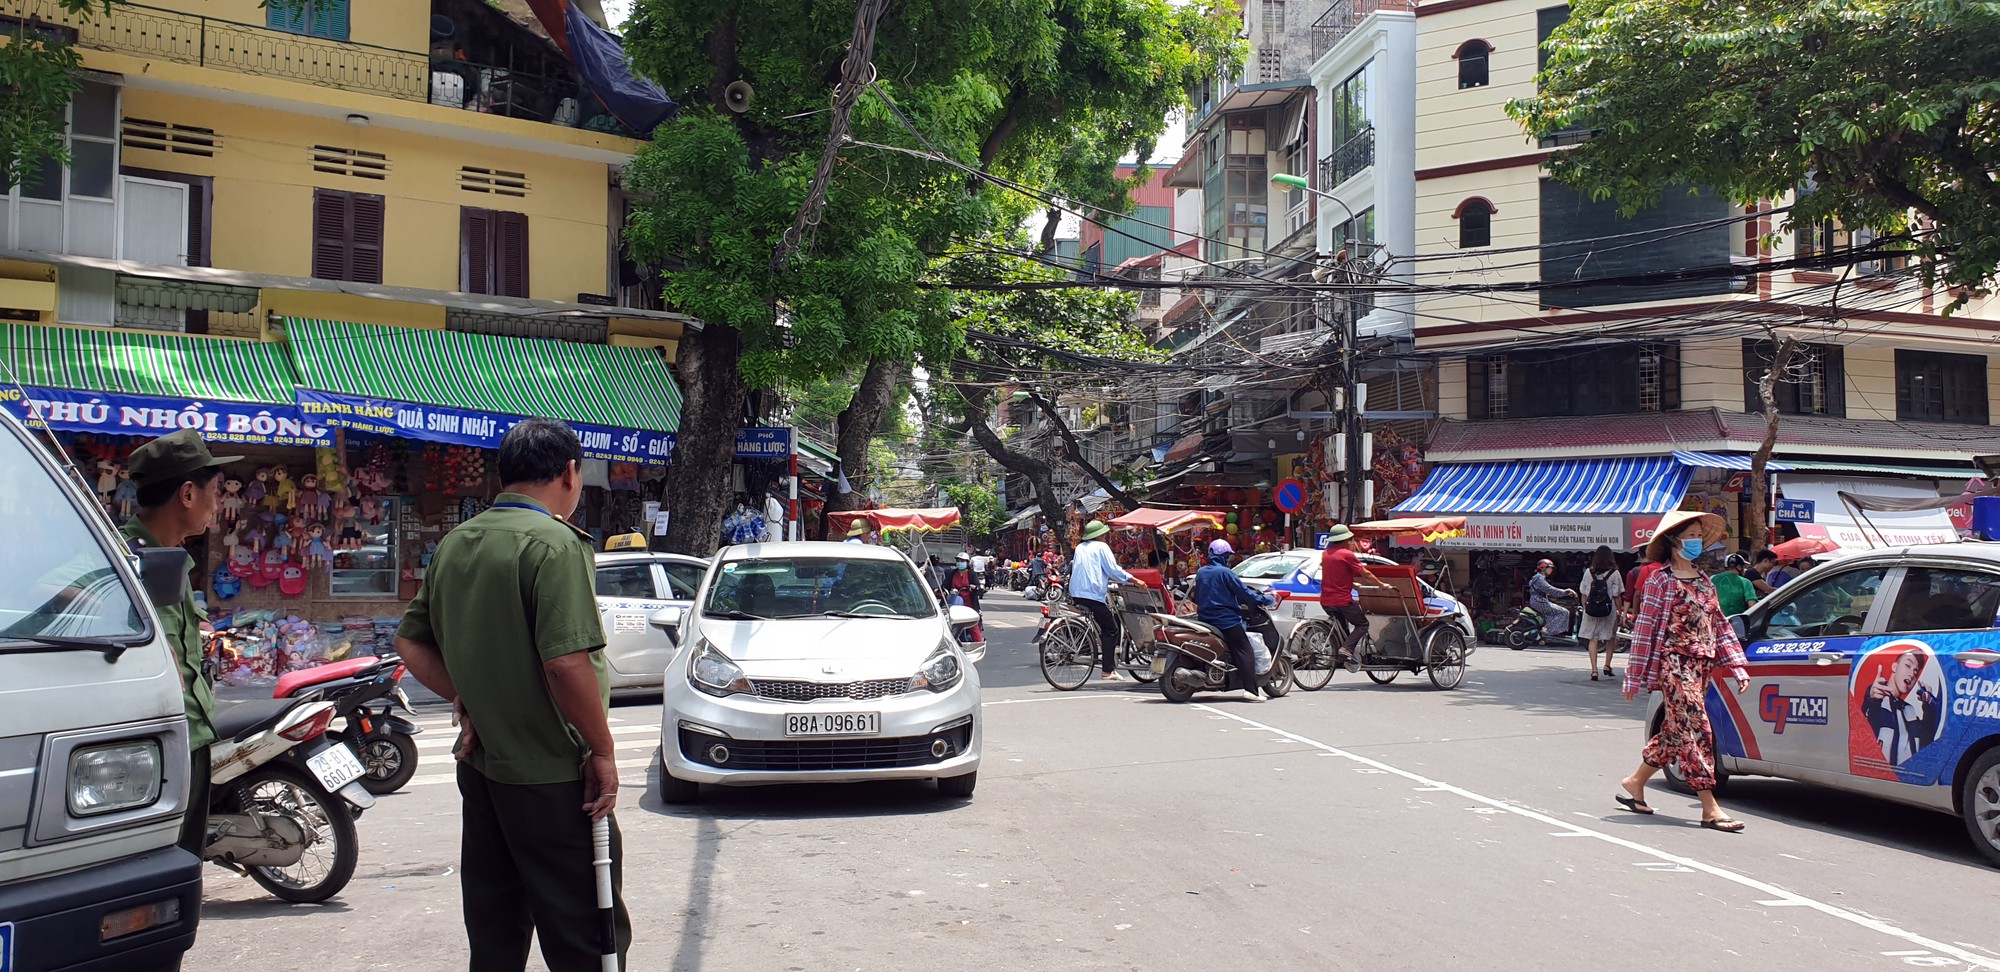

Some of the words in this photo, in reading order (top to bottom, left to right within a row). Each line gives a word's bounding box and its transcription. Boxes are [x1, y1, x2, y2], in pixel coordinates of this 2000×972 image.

[22, 398, 111, 424] THÚ
[120, 402, 219, 431] NHỒI
[228, 410, 328, 438] BÔNG
[301, 402, 352, 414] THANH
[354, 400, 394, 418] HẰNG
[352, 421, 373, 431] HÀNG
[375, 425, 395, 434] LƯỢC
[397, 408, 424, 429] QUÀ
[428, 413, 459, 434] SINH
[462, 416, 497, 440] NHẬT
[621, 431, 641, 453] SỔ
[757, 431, 775, 439] PHỐ
[737, 440, 761, 452] HÀNG
[763, 441, 786, 455] LƯỢC
[1778, 508, 1797, 518] CHẢ
[1798, 509, 1811, 519] CÁ
[1462, 521, 1481, 539] ÀNG
[1483, 525, 1505, 539] MINH
[1506, 520, 1522, 539] YẾN
[1634, 528, 1655, 539] de
[1894, 535, 1922, 544] MINH
[1955, 675, 1981, 696] CỨ
[1759, 684, 1790, 735] G7
[1790, 698, 1827, 717] TAXI
[1953, 696, 1977, 716] CỨ
[789, 714, 874, 732] 88A-096.61
[322, 760, 361, 789] 660.75
